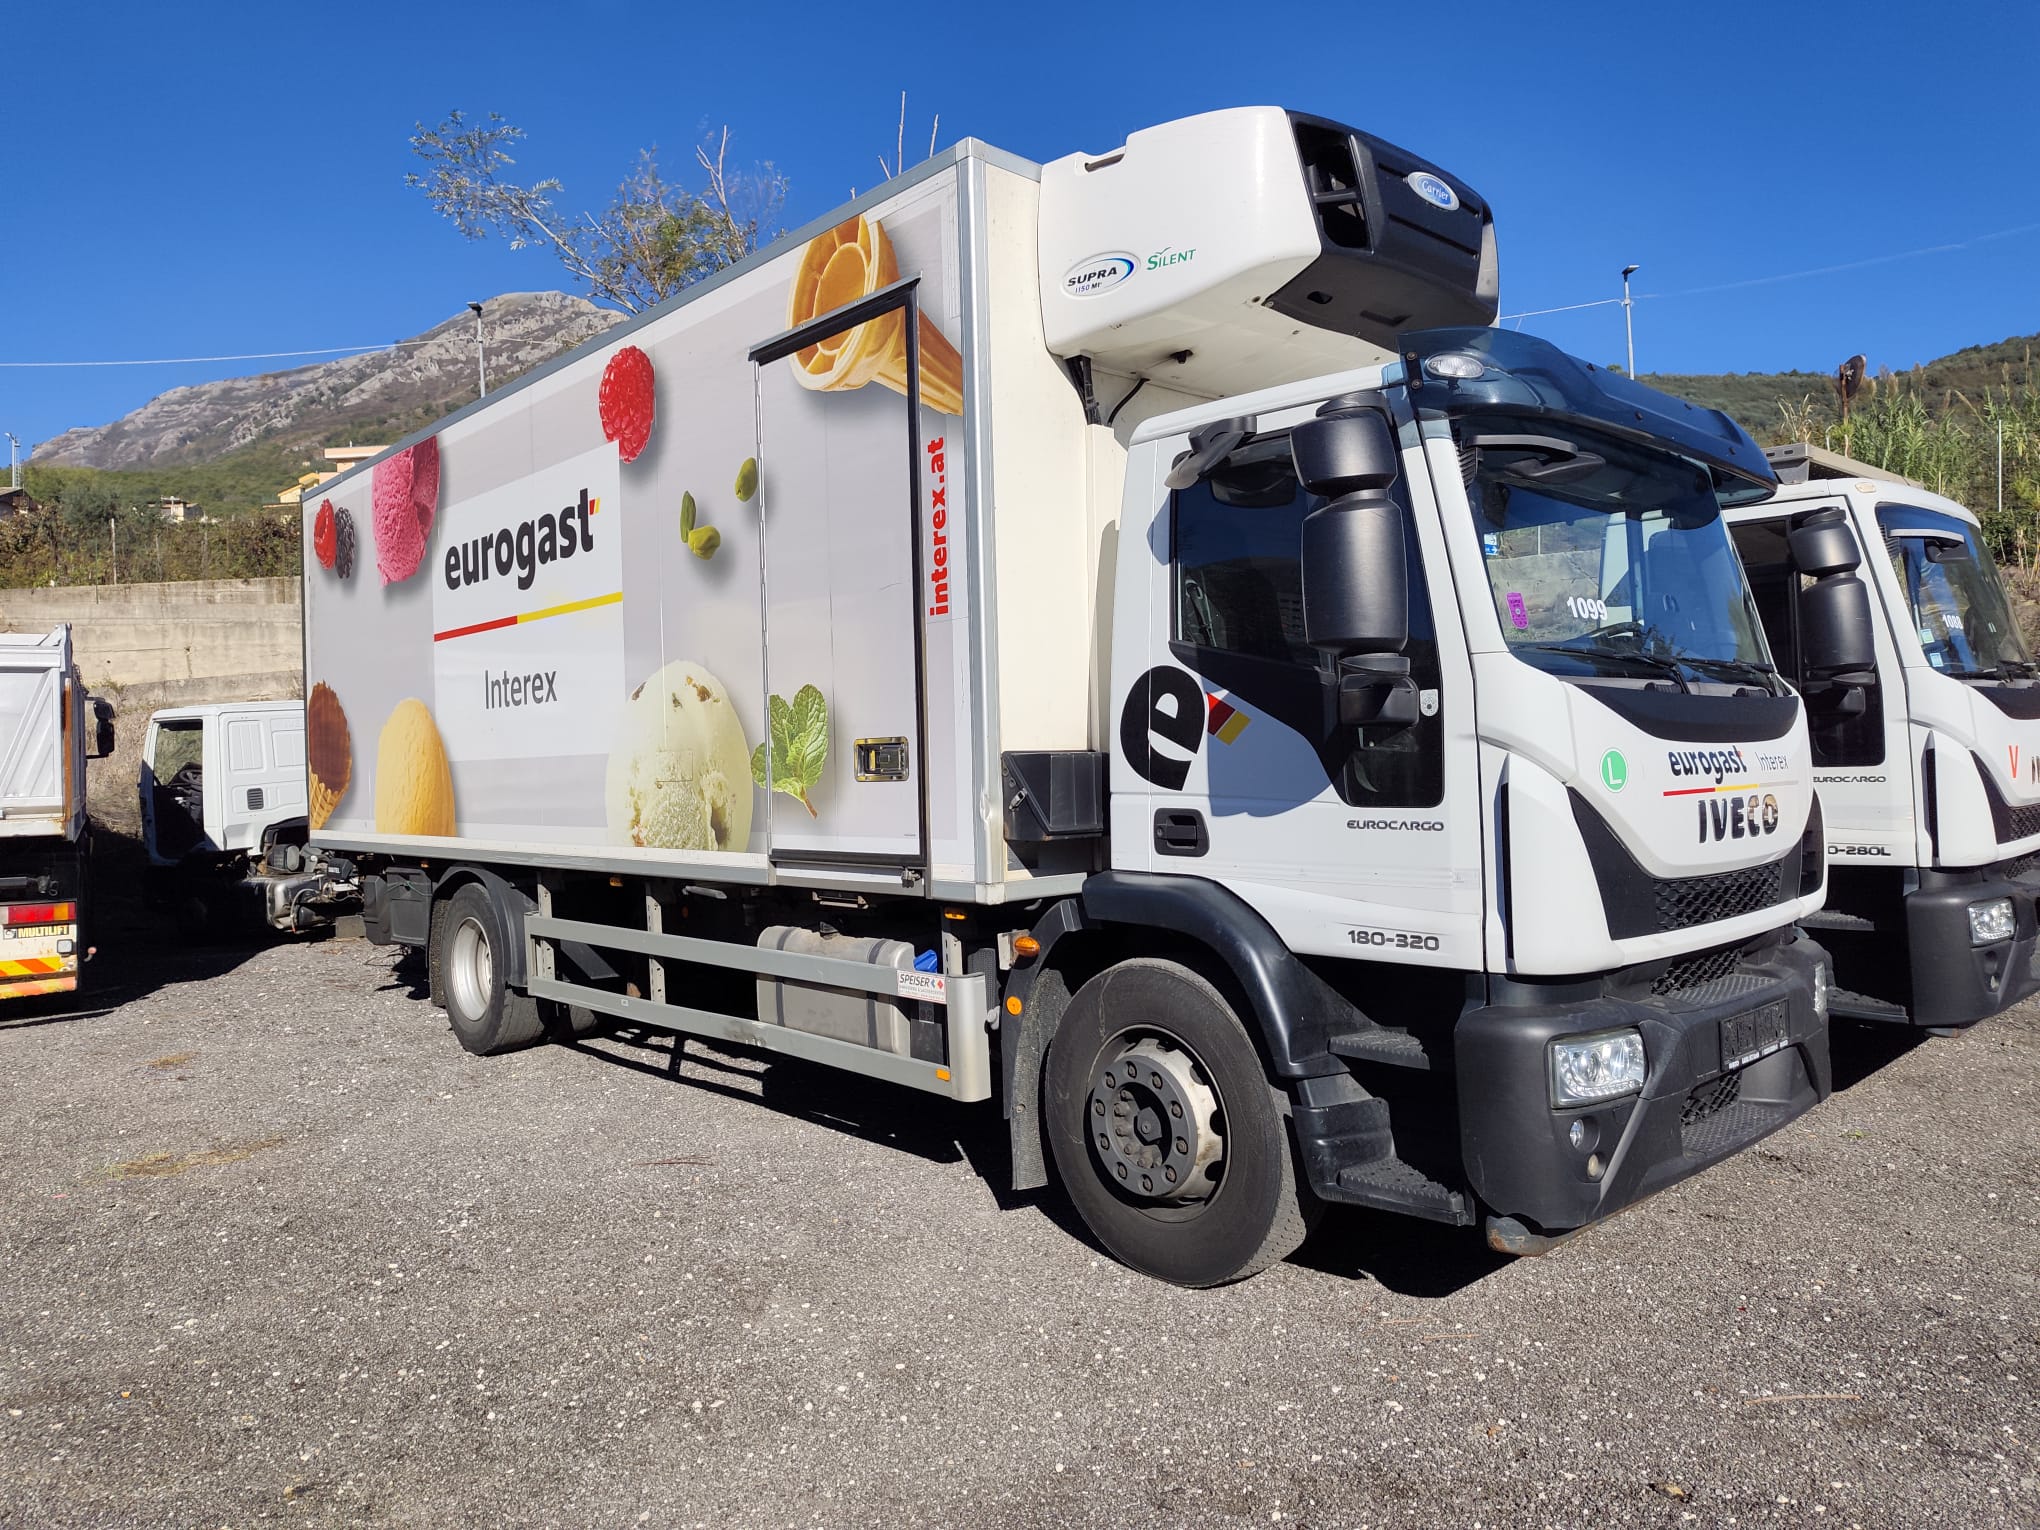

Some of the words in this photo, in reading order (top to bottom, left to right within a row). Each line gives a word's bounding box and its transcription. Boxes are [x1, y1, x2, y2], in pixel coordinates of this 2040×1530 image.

[1422, 181, 1449, 201] Carrier
[1147, 247, 1197, 270] SILENT
[1067, 266, 1118, 287] SUPRA
[928, 437, 948, 616] interex.at
[445, 488, 594, 590] eurogast
[1567, 596, 1607, 620] 1099
[485, 669, 557, 710] Interex
[1120, 665, 1205, 791] e
[1607, 757, 1622, 784] L
[1668, 745, 1747, 784] eurogast
[1755, 752, 1788, 771] Interex
[1813, 775, 1887, 783] EUROCARGO
[1347, 820, 1444, 831] EUROCARGO
[1698, 793, 1778, 844] IVECO
[17, 925, 69, 938] MULTILIFT
[1348, 930, 1440, 951] 180-320
[900, 973, 930, 988] SPEISER
